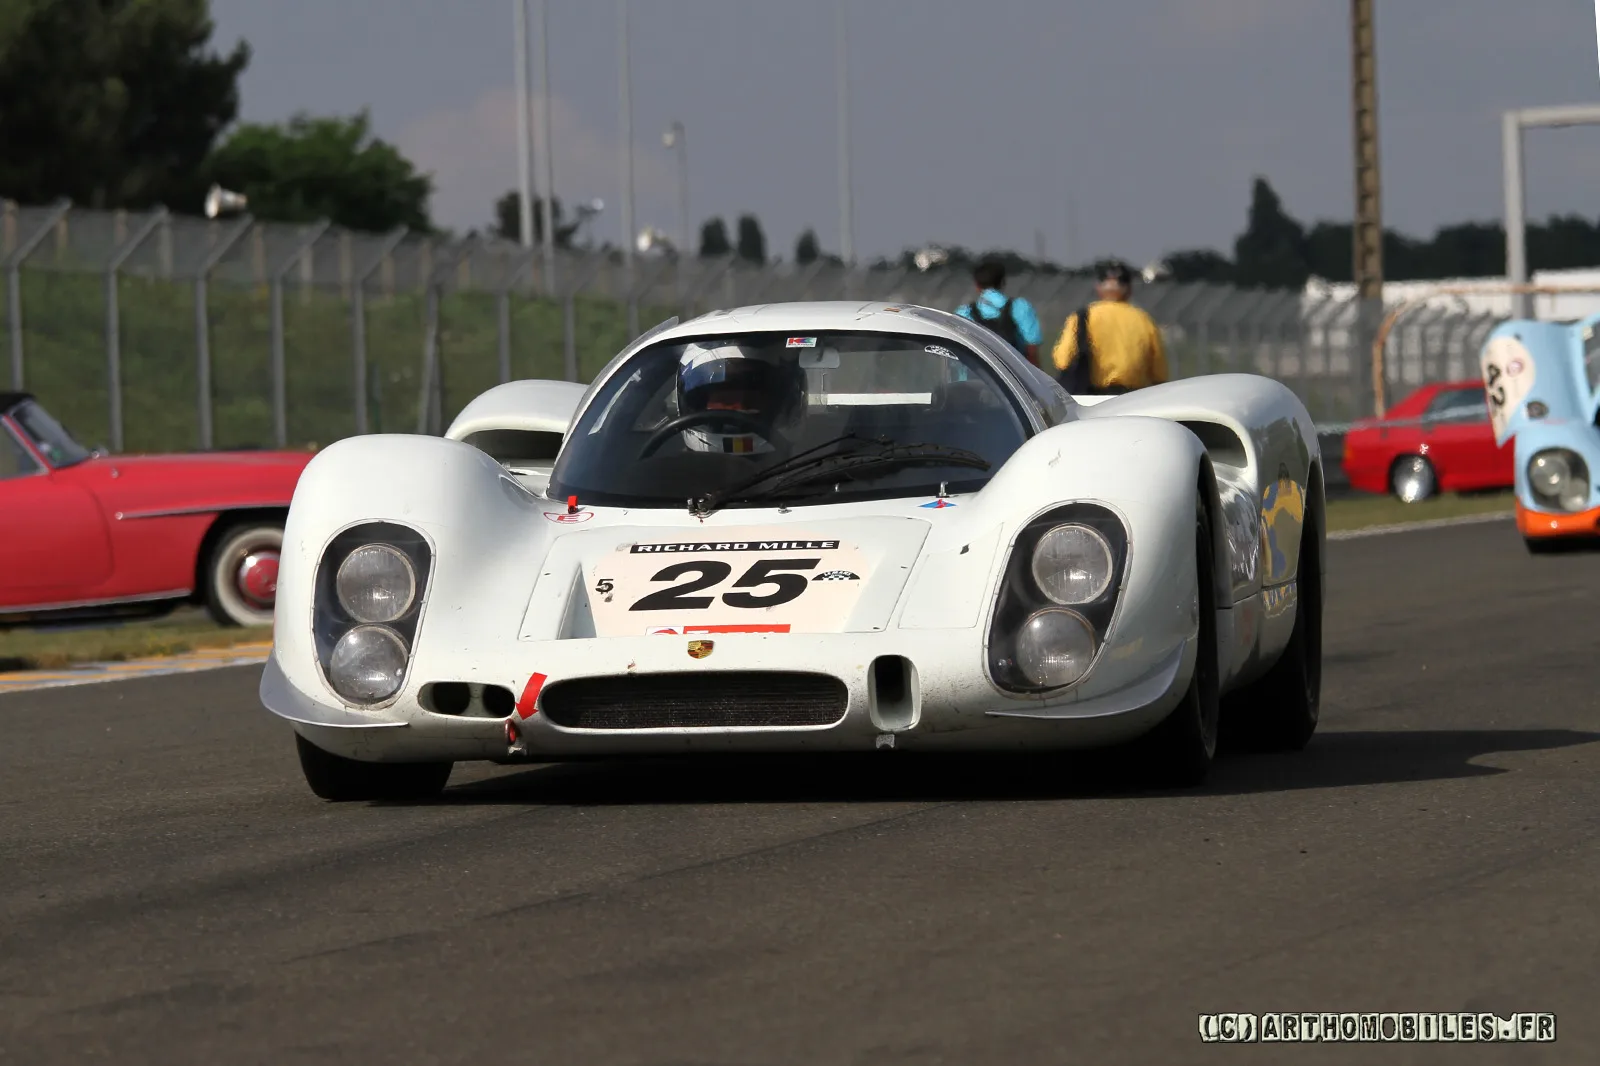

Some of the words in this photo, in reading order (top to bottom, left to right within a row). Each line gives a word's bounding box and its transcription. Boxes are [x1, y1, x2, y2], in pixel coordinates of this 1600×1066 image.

[637, 543, 748, 553] RICHARD
[758, 541, 835, 550] MILLE
[628, 558, 822, 611] 25
